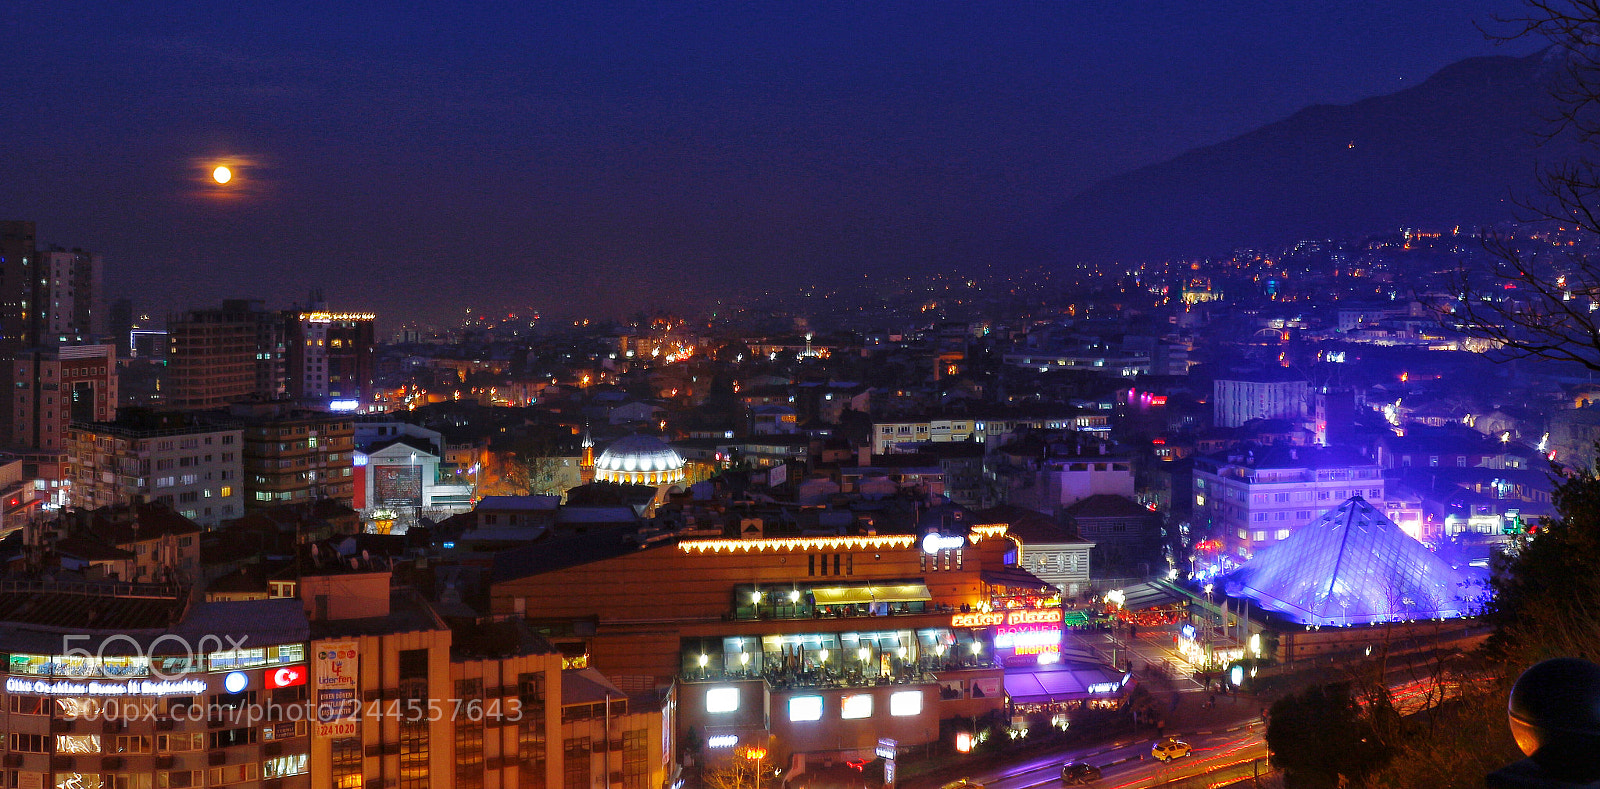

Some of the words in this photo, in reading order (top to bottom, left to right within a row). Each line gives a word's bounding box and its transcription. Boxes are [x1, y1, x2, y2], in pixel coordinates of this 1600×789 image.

[952, 613, 1004, 627] zafer
[1008, 610, 1061, 625] plaza
[1015, 644, 1059, 655] MIGROS
[335, 724, 344, 734] 10
[345, 723, 355, 734] 20
